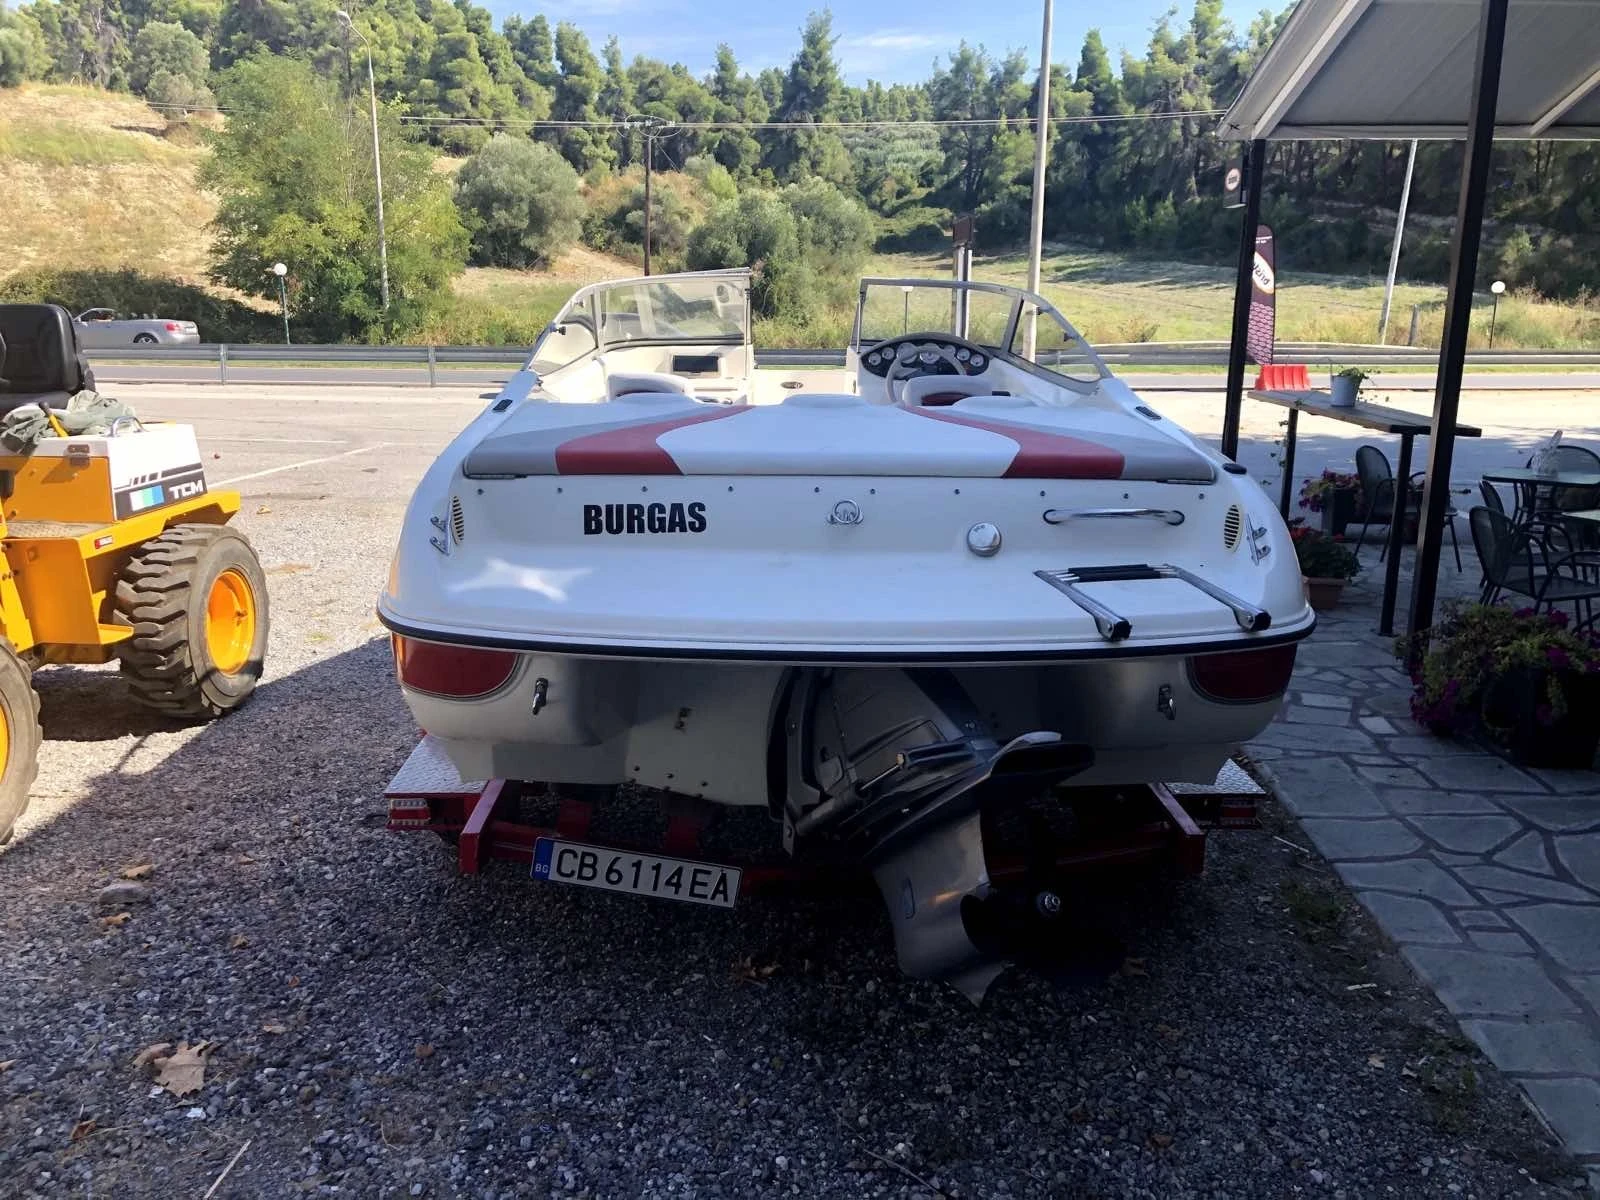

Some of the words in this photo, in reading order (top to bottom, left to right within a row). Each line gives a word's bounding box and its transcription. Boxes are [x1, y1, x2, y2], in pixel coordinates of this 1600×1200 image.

[168, 479, 204, 500] TCM
[583, 501, 707, 535] BURGAS
[535, 863, 549, 873] BG
